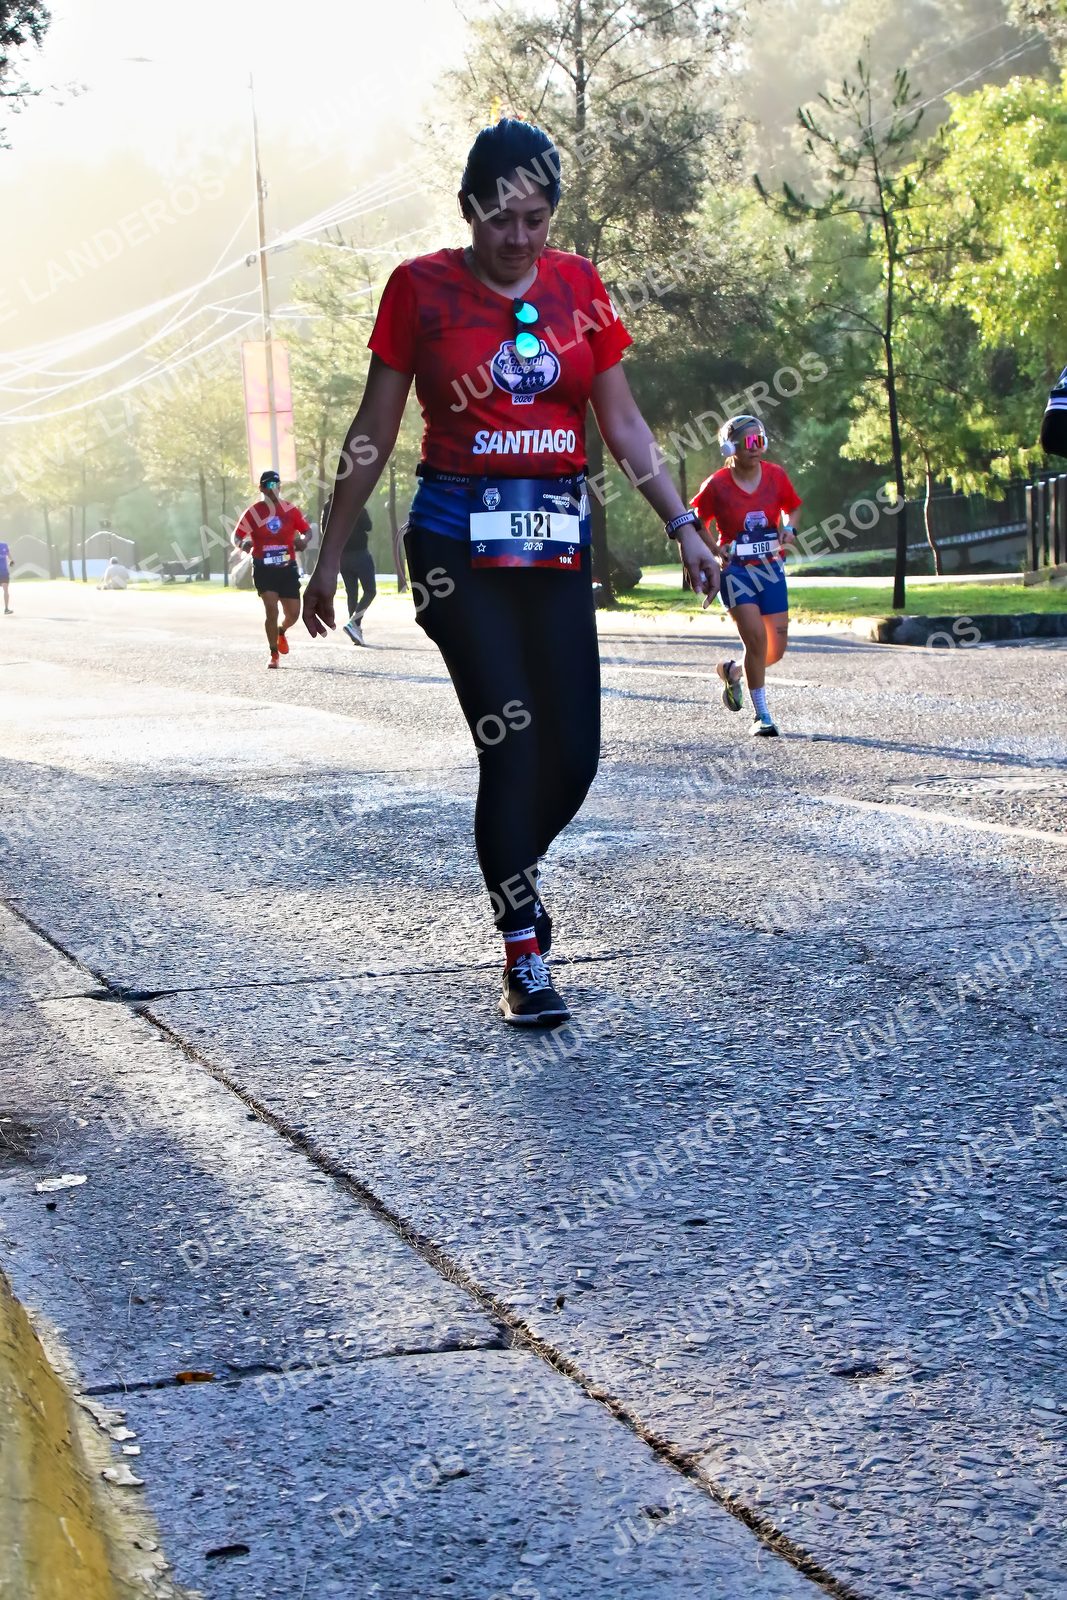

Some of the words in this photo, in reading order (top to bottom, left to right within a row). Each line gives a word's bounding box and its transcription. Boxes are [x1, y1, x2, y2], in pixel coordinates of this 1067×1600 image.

[501, 363, 531, 374] Race
[513, 395, 533, 403] 2026
[472, 429, 576, 455] SANTIAGO
[510, 513, 551, 538] 5121
[752, 541, 770, 553] 5160
[559, 556, 573, 564] 10K
